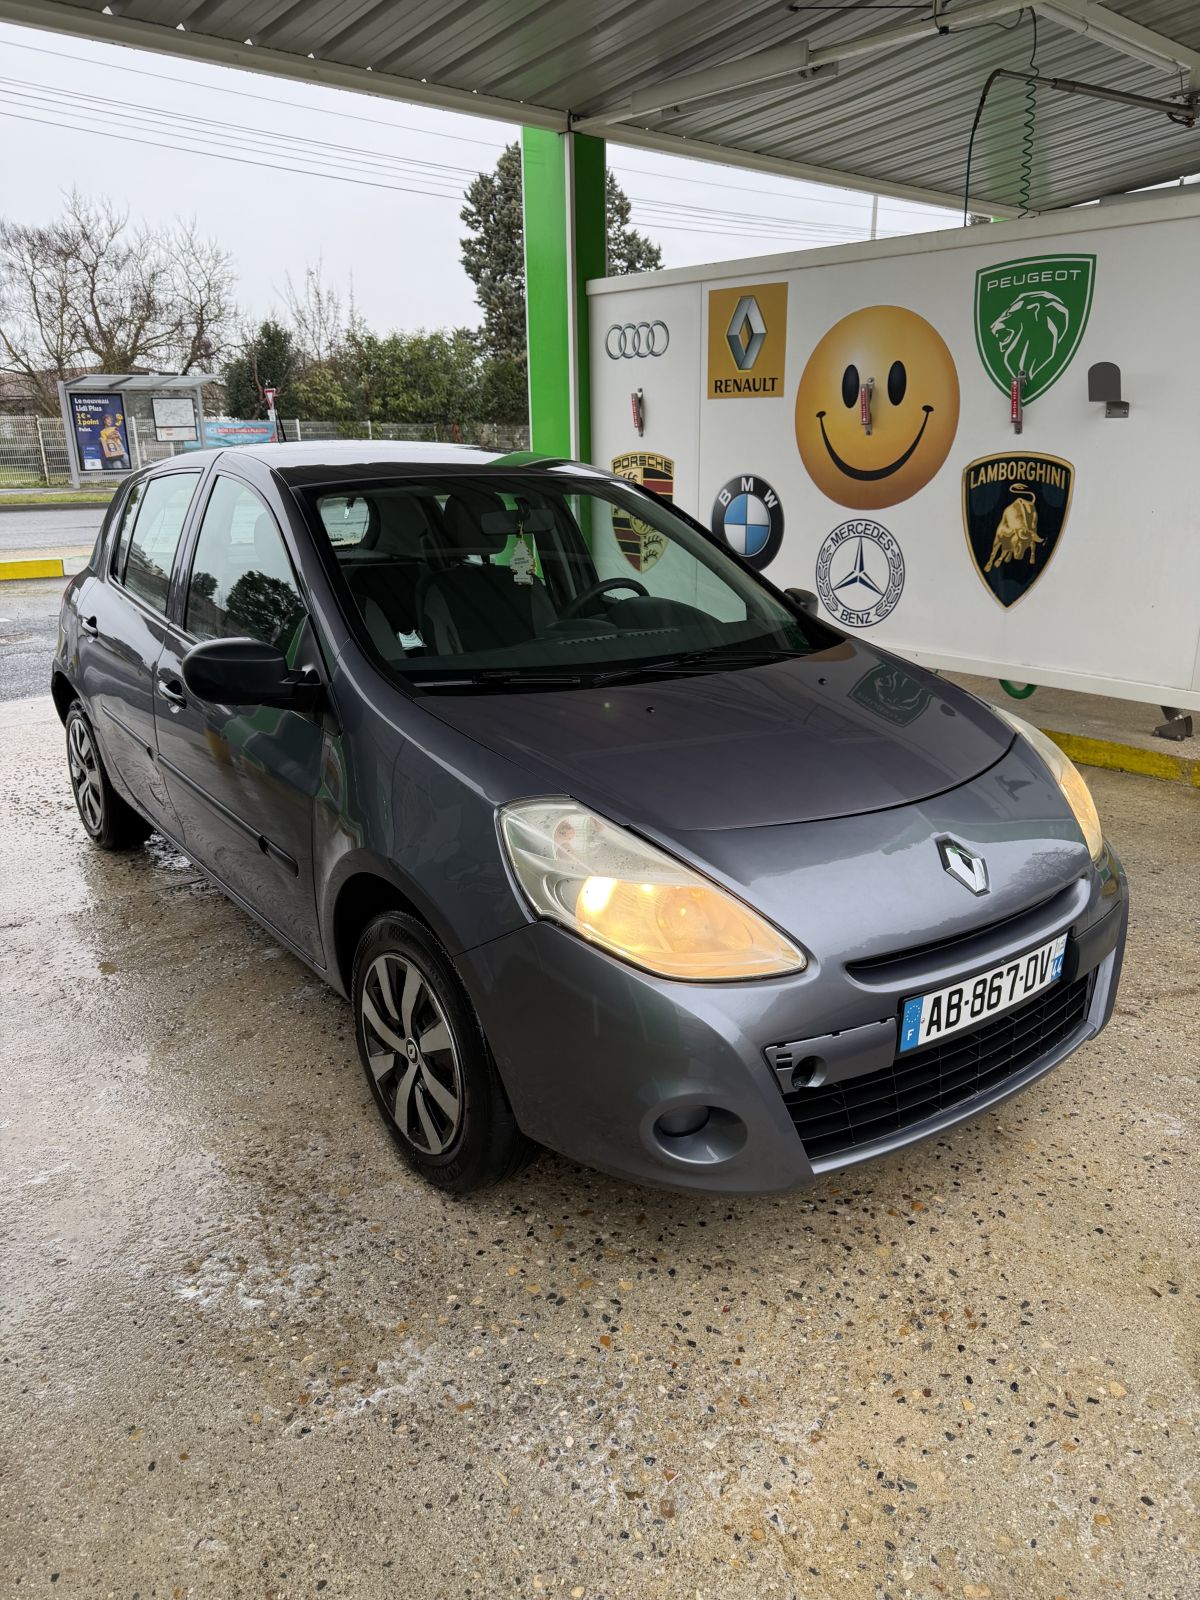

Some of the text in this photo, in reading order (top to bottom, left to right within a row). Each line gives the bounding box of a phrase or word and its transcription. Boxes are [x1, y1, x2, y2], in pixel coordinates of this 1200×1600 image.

[986, 269, 1082, 292] PEUGEOT
[714, 377, 779, 394] RENAULT
[613, 455, 673, 475] PORSCHE
[969, 461, 1067, 490] LAMBORGHINI
[718, 477, 779, 509] BMW
[830, 522, 894, 551] MERCEDES
[840, 608, 873, 625] BENZ
[906, 1028, 915, 1041] F
[925, 946, 1053, 1037] AB-867-DV
